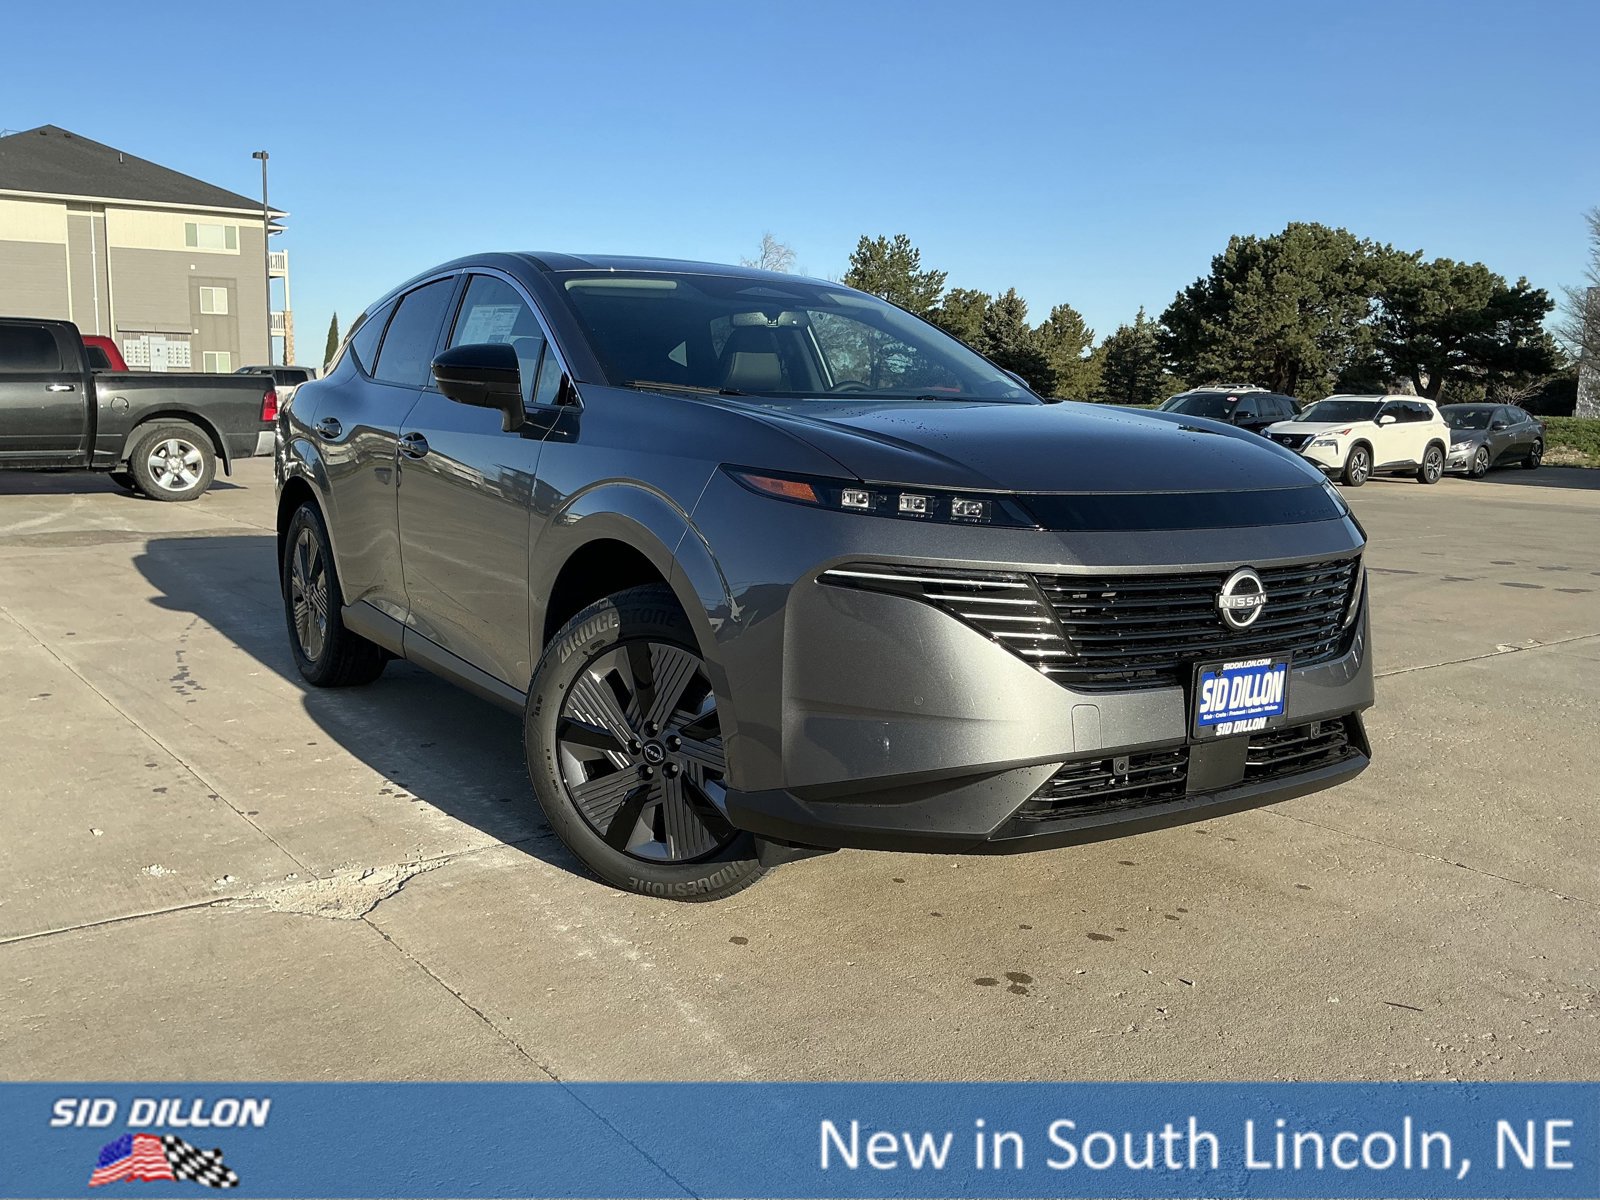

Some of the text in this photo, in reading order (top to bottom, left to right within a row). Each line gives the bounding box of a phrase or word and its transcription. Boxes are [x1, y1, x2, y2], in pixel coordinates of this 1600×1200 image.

[1220, 593, 1267, 607] NISSAN
[1223, 658, 1271, 670] SIDDILLON.COM
[1200, 670, 1285, 713] SID DILLON
[1215, 716, 1267, 736] SID DILLON
